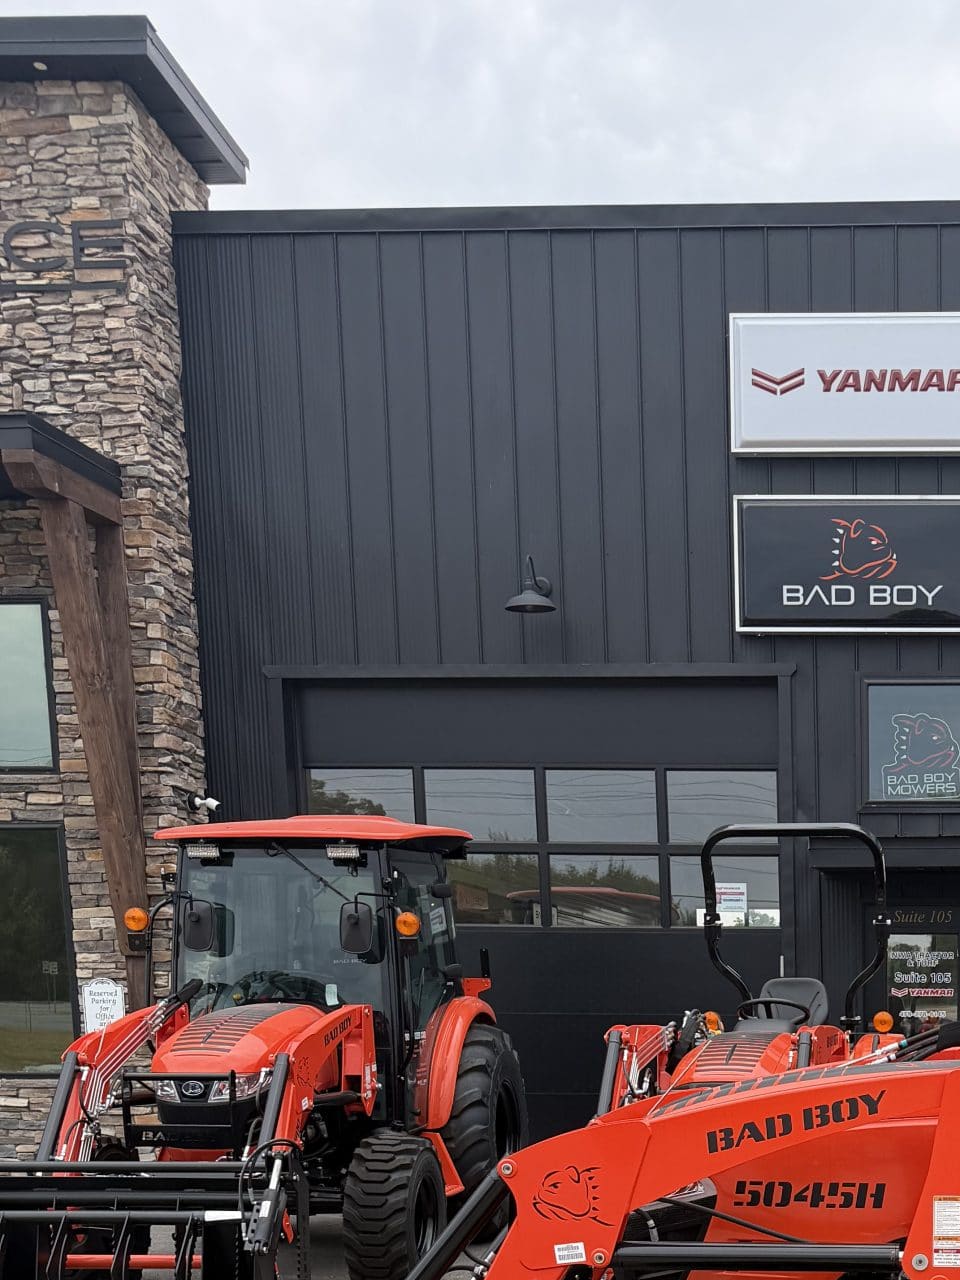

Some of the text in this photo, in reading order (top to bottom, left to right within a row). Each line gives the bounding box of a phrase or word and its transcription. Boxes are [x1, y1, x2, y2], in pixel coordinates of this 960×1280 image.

[782, 584, 943, 606] BAD BOY
[887, 772, 956, 785] BAD BOY
[887, 782, 957, 796] MOWERS
[894, 910, 953, 923] Suite 105
[894, 971, 952, 984] Suite 105
[909, 988, 954, 997] YANMAR
[706, 1090, 887, 1154] BAD BOY
[733, 1180, 887, 1209] 5045H
